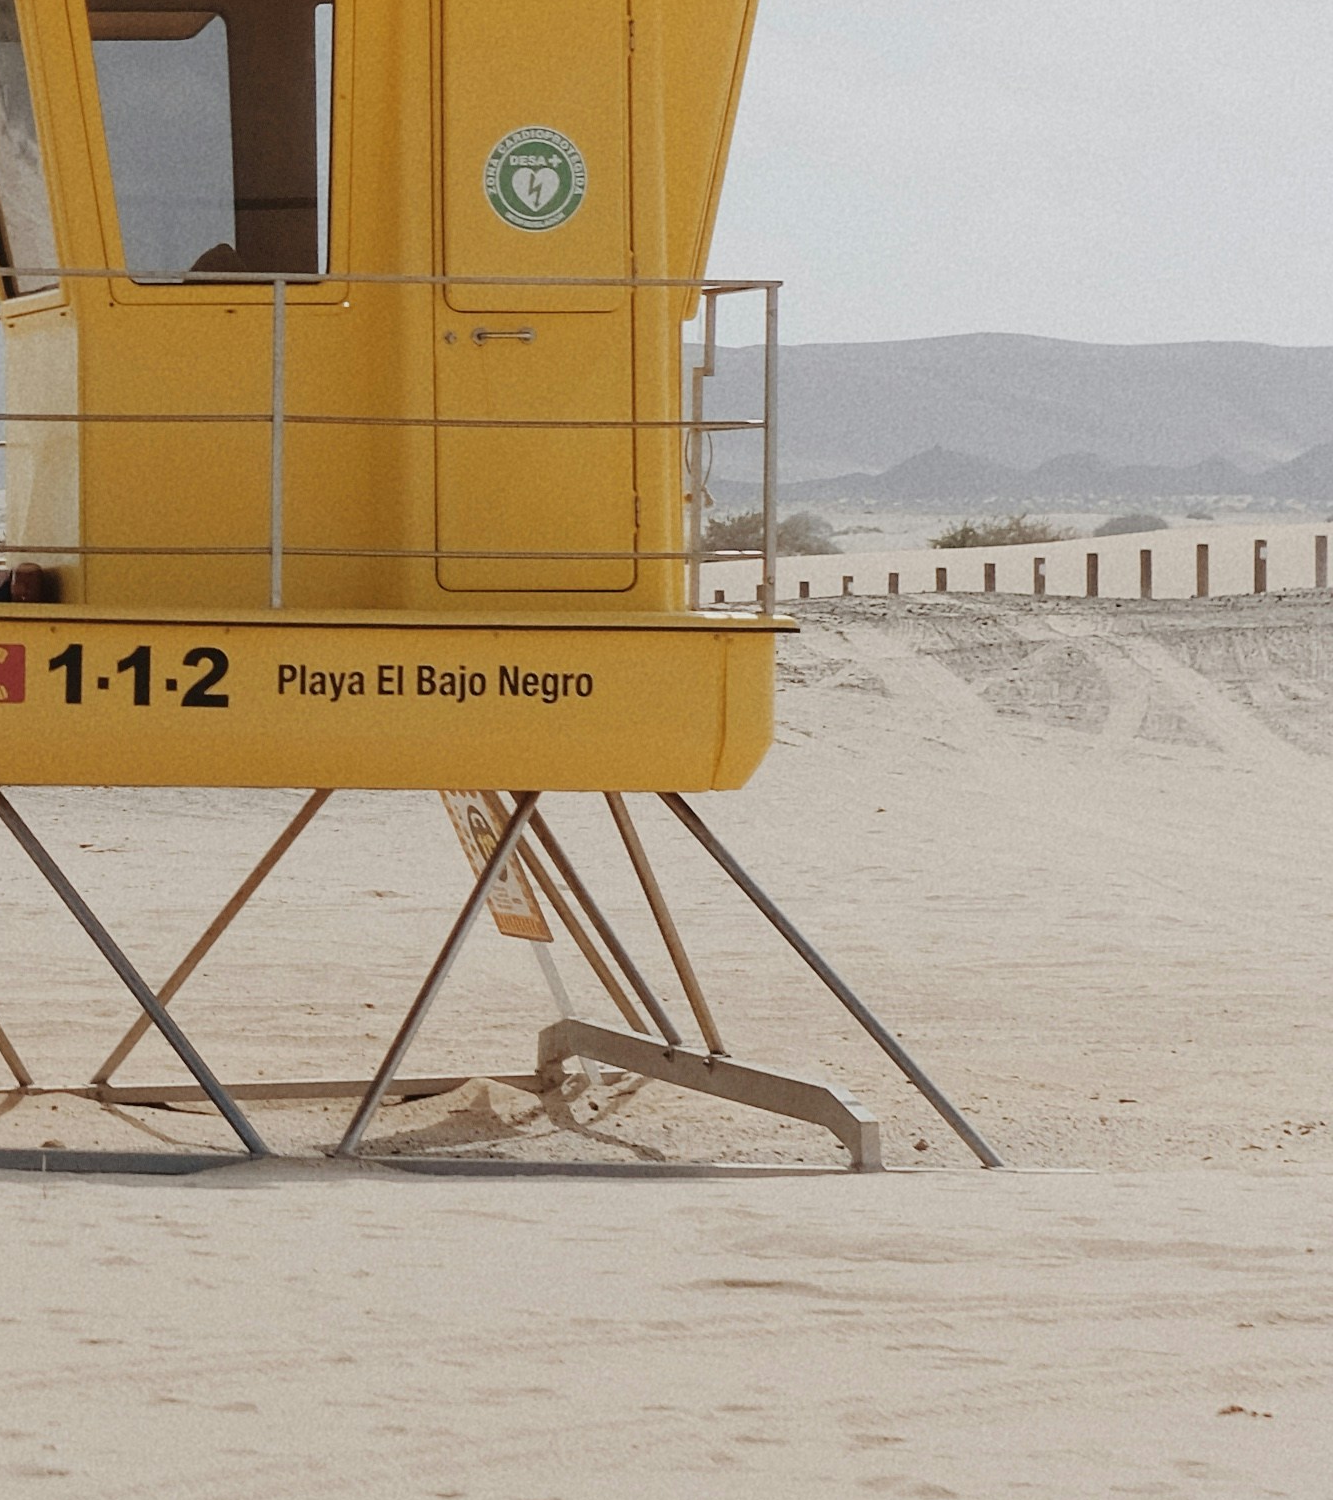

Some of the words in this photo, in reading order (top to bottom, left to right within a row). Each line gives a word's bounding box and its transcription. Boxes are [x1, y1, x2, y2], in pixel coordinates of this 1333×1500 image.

[486, 158, 499, 194] ZONA
[509, 155, 547, 166] DESA
[278, 664, 365, 703] Playa
[377, 664, 404, 696] El
[416, 665, 487, 703] Bajo
[499, 665, 593, 704] Negro
